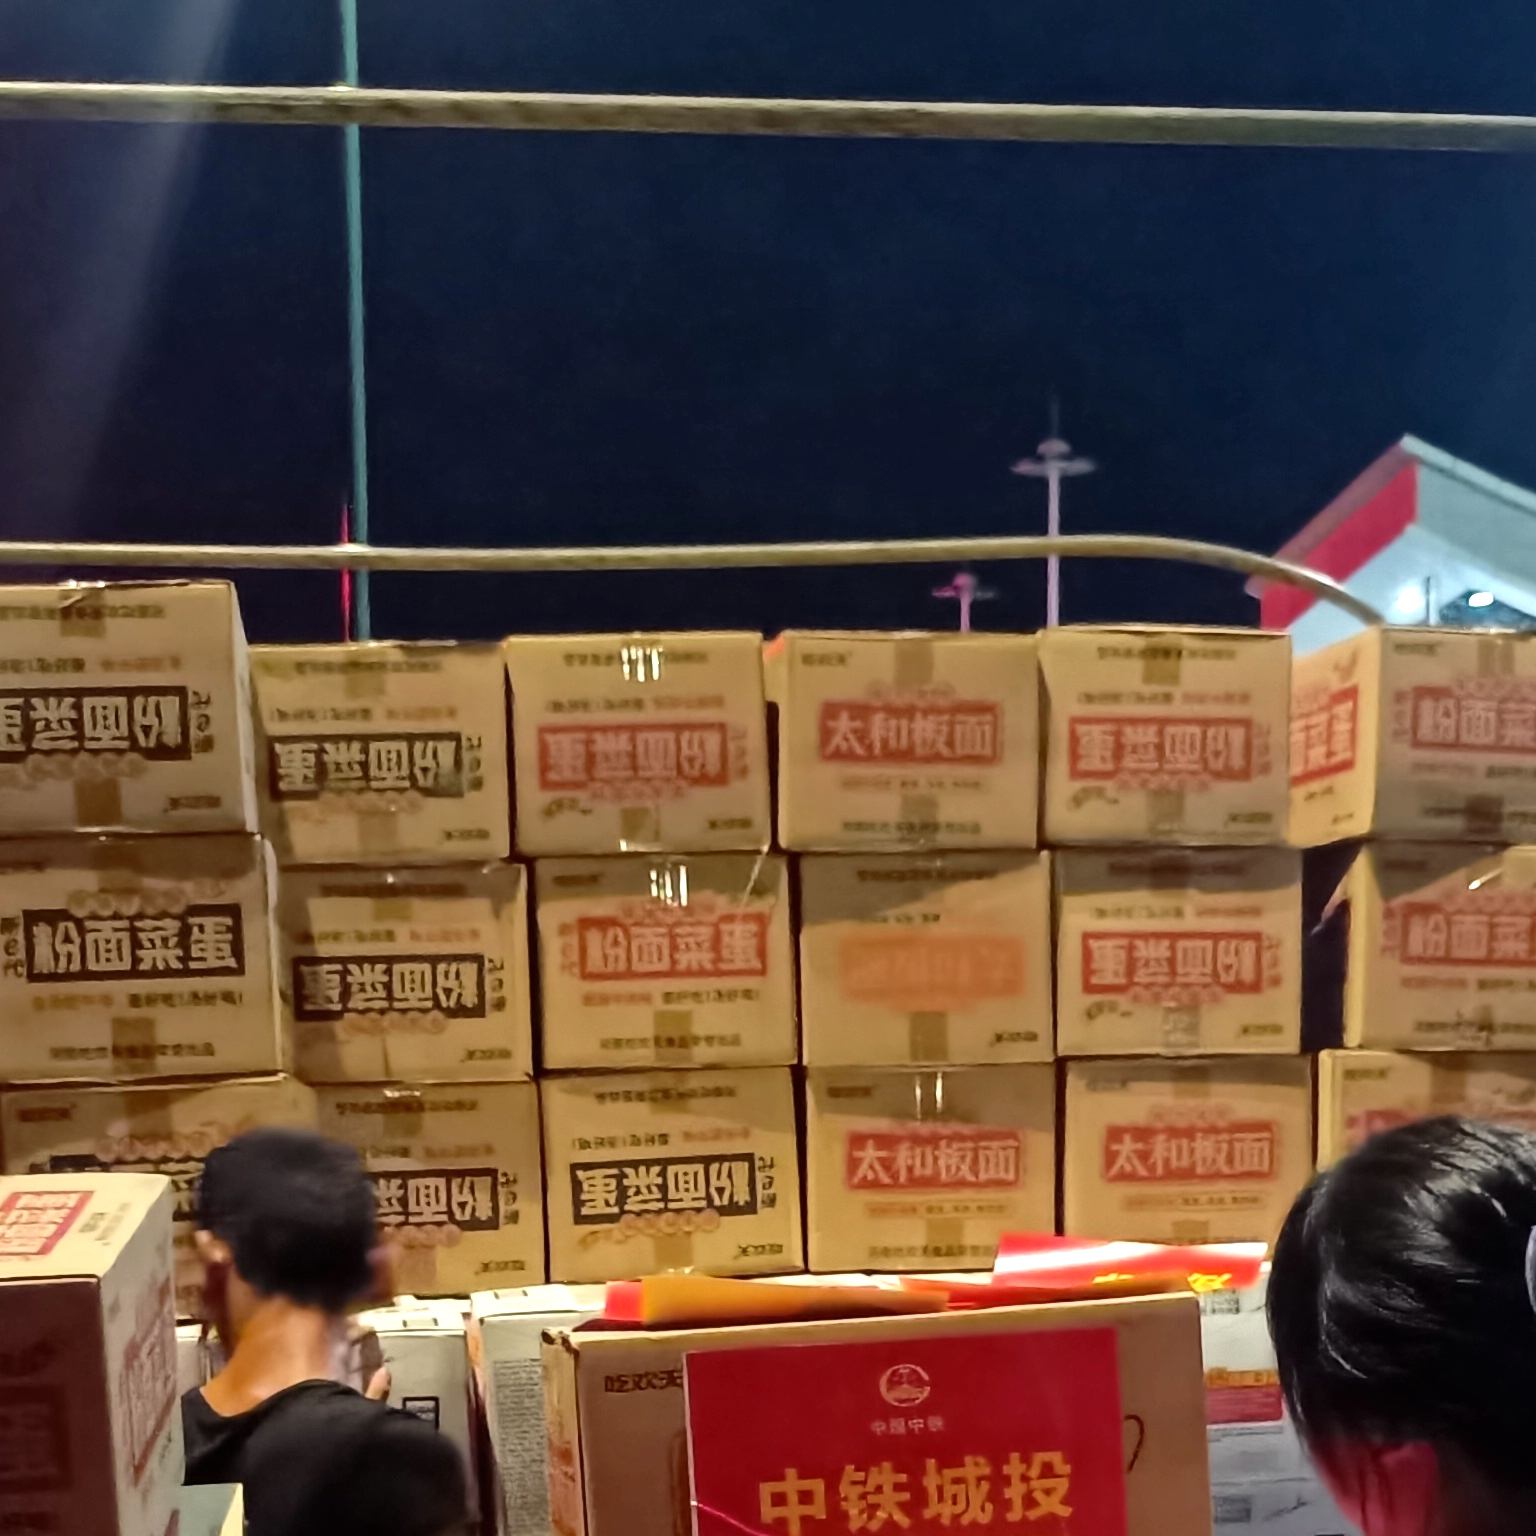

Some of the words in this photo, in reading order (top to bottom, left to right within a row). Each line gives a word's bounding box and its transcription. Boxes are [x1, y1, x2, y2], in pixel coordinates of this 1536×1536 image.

[825, 711, 996, 757] 太和板面
[32, 916, 238, 973] 粉面菜蛋
[584, 922, 762, 972] 粉面菜蛋
[299, 961, 479, 1010] 粉面菜蛋
[851, 1139, 1019, 1185] 太和板面
[1109, 1131, 1274, 1178] 太和板面
[575, 1158, 752, 1216] 粉面菜蛋
